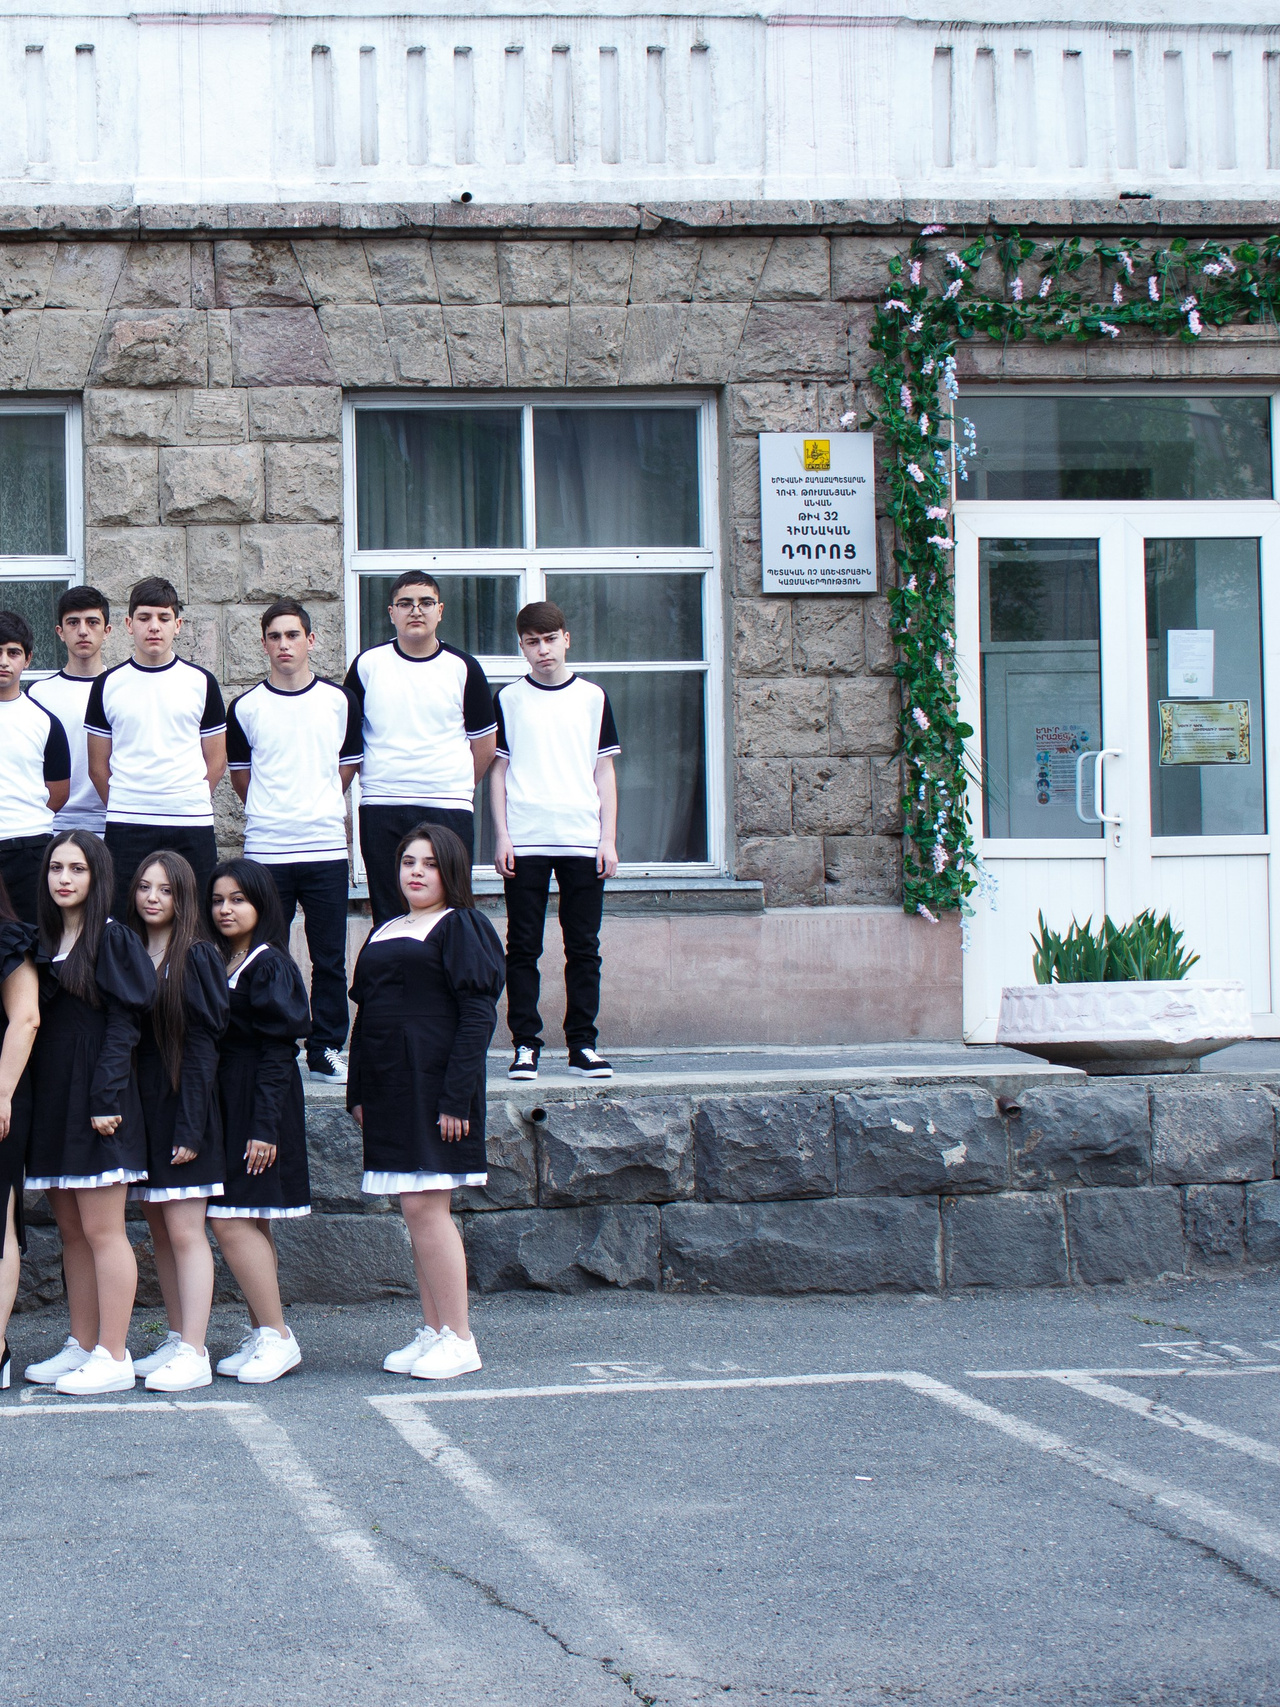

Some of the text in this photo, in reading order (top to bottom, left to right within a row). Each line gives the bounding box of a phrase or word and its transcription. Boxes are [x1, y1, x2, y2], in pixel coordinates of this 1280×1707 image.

[771, 476, 866, 484] ԵՐԵՎԱՆԻ ՔԱՂԱՔԱՊԵՏԱՐԱՆ
[800, 489, 857, 497] ԹՈՒՄԱՆՅԱՆԻ
[803, 499, 832, 507] ԱՆՎԱՆ
[798, 511, 839, 521] ԹԻՎ 32
[787, 526, 850, 535] ՀԻՄՆԱԿԱՆ
[781, 543, 857, 560] ԴՊՐՈՑ
[767, 568, 871, 576] ՊԵՏԱԿԱՆ ՈՉ ԱՌԵՎՏՐԱՅԻՆ
